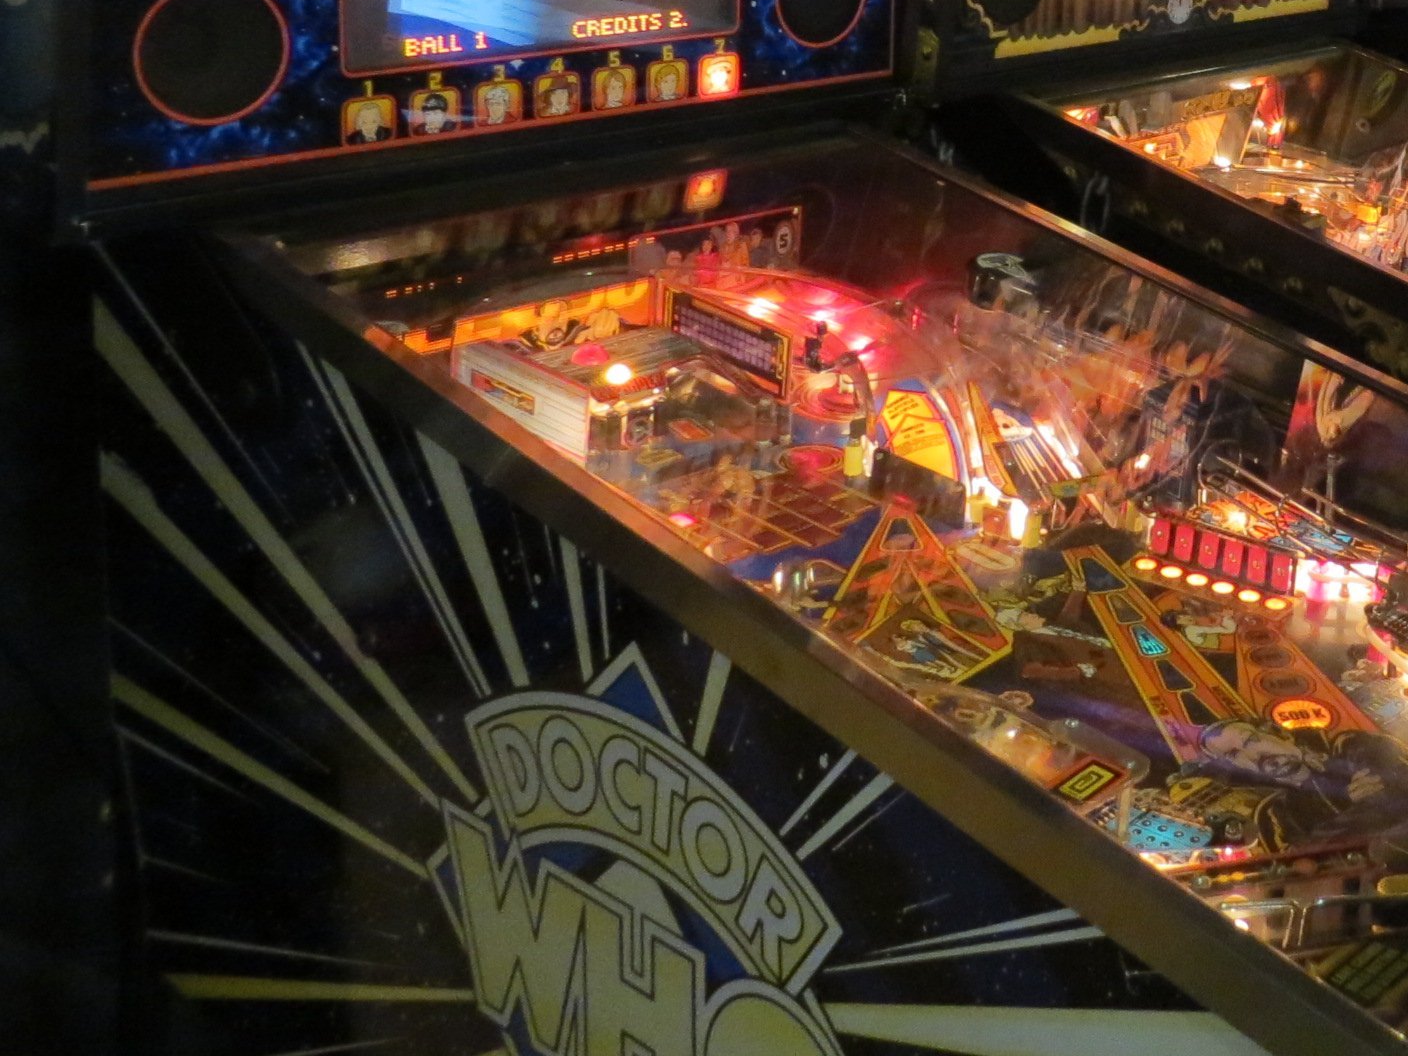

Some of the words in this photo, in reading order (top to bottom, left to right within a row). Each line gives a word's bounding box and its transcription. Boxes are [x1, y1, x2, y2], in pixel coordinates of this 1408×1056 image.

[571, 12, 663, 39] CREDITS
[403, 34, 463, 58] BALL
[474, 31, 488, 50] 1
[552, 57, 565, 75] 4
[609, 50, 620, 68] 5
[363, 80, 375, 98] 1
[488, 714, 804, 989] DOCTOR
